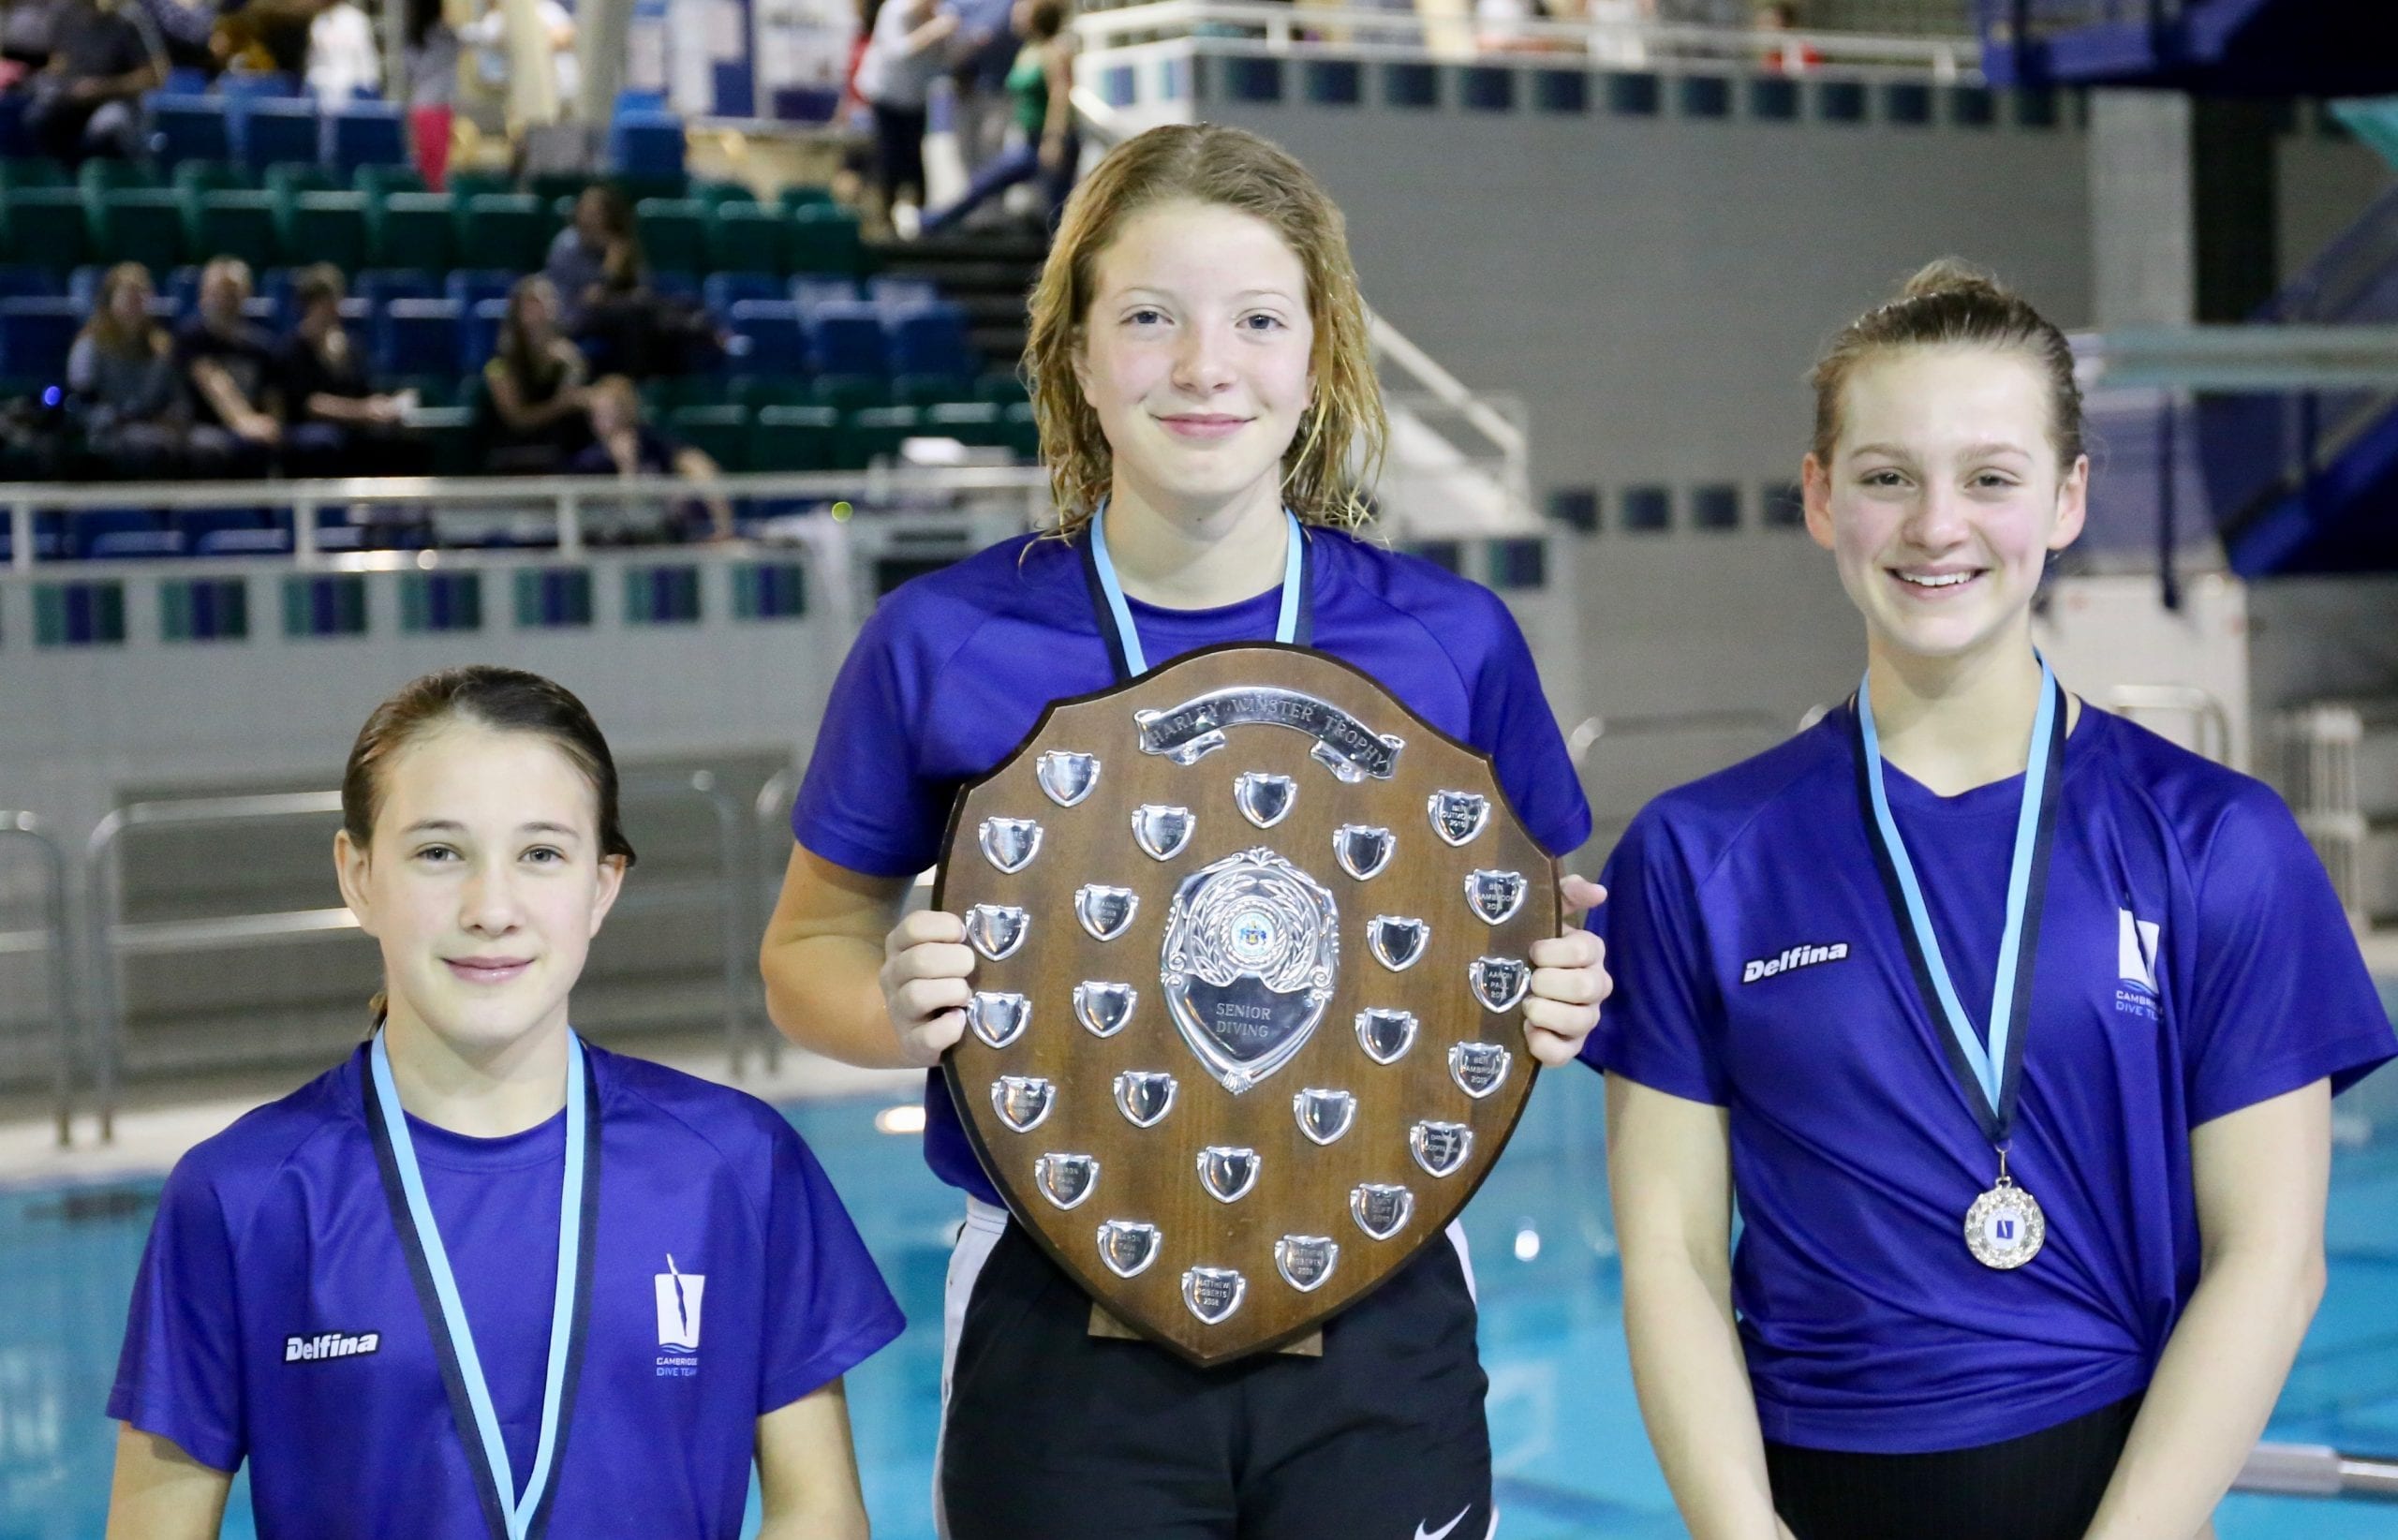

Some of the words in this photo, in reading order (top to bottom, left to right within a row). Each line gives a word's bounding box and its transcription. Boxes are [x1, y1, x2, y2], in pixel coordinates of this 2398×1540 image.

[1146, 700, 1220, 747] HARLEY
[1232, 695, 1313, 722] WINSTER
[1324, 716, 1387, 767] TROPHY
[1743, 942, 1848, 983] Delfina
[1216, 1002, 1271, 1020] SENIOR
[2115, 1000, 2143, 1017] DIVE
[1216, 1020, 1268, 1038] DIVING
[285, 1333, 378, 1362] Delfina
[656, 1367, 678, 1377] DIVE
